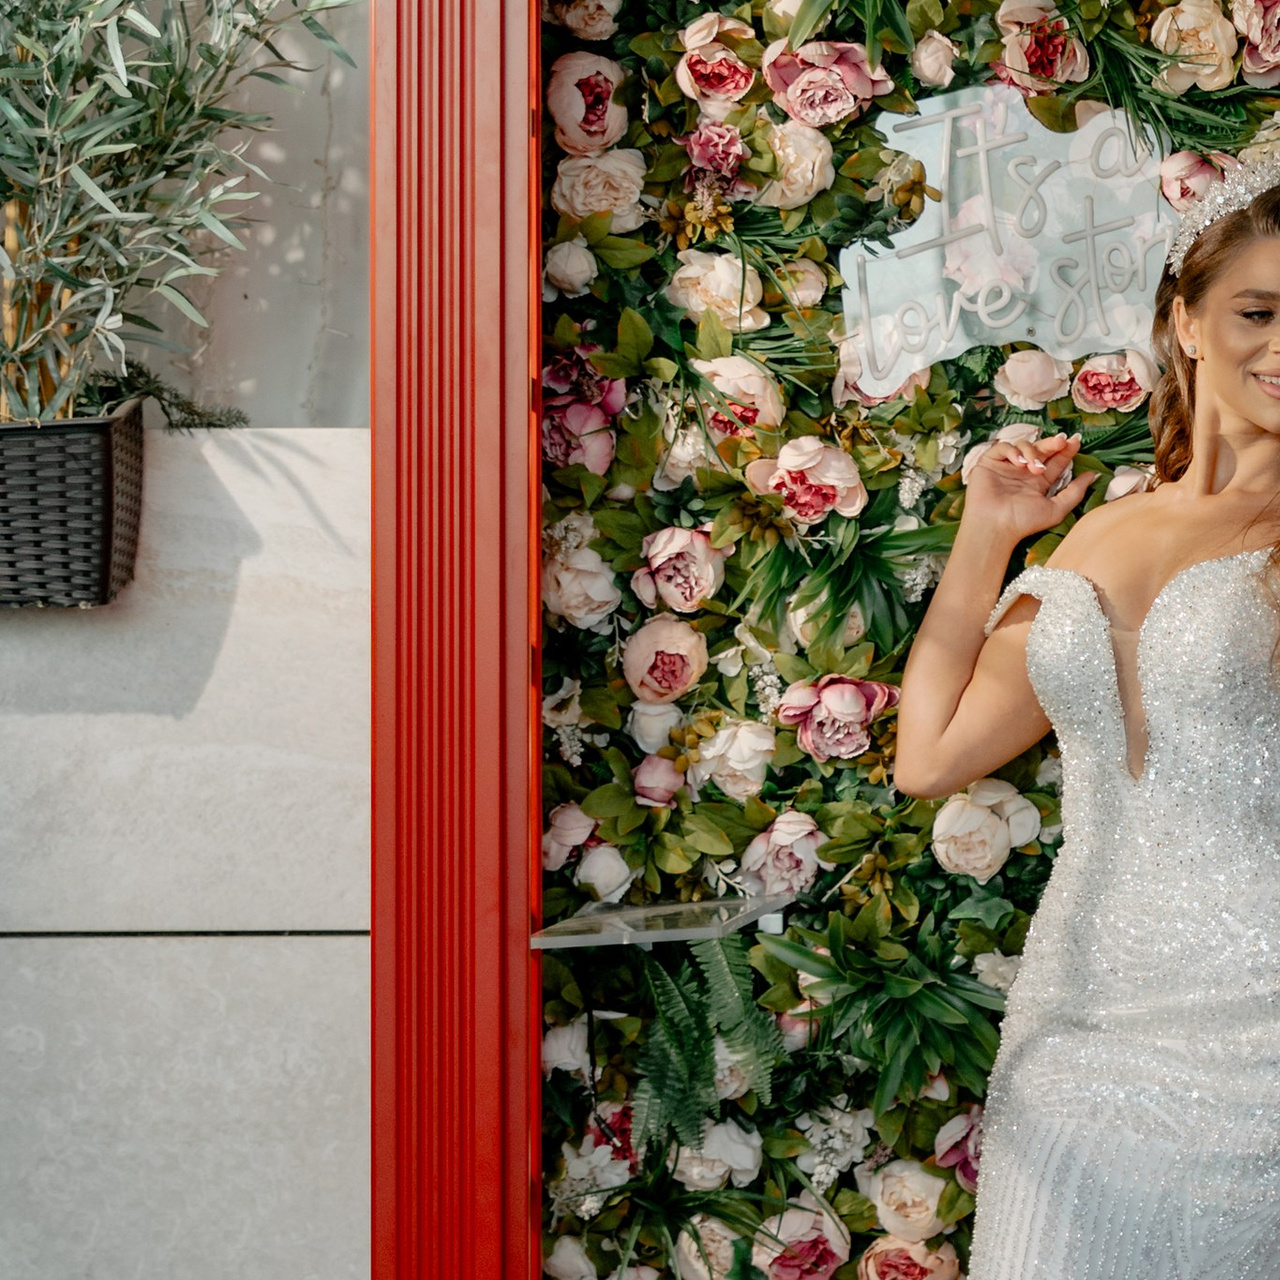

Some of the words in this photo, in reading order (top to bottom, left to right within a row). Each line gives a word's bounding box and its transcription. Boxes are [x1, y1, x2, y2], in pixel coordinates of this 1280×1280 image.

[893, 101, 1061, 258] It's
[1091, 127, 1155, 180] a
[1050, 195, 1174, 344] stor
